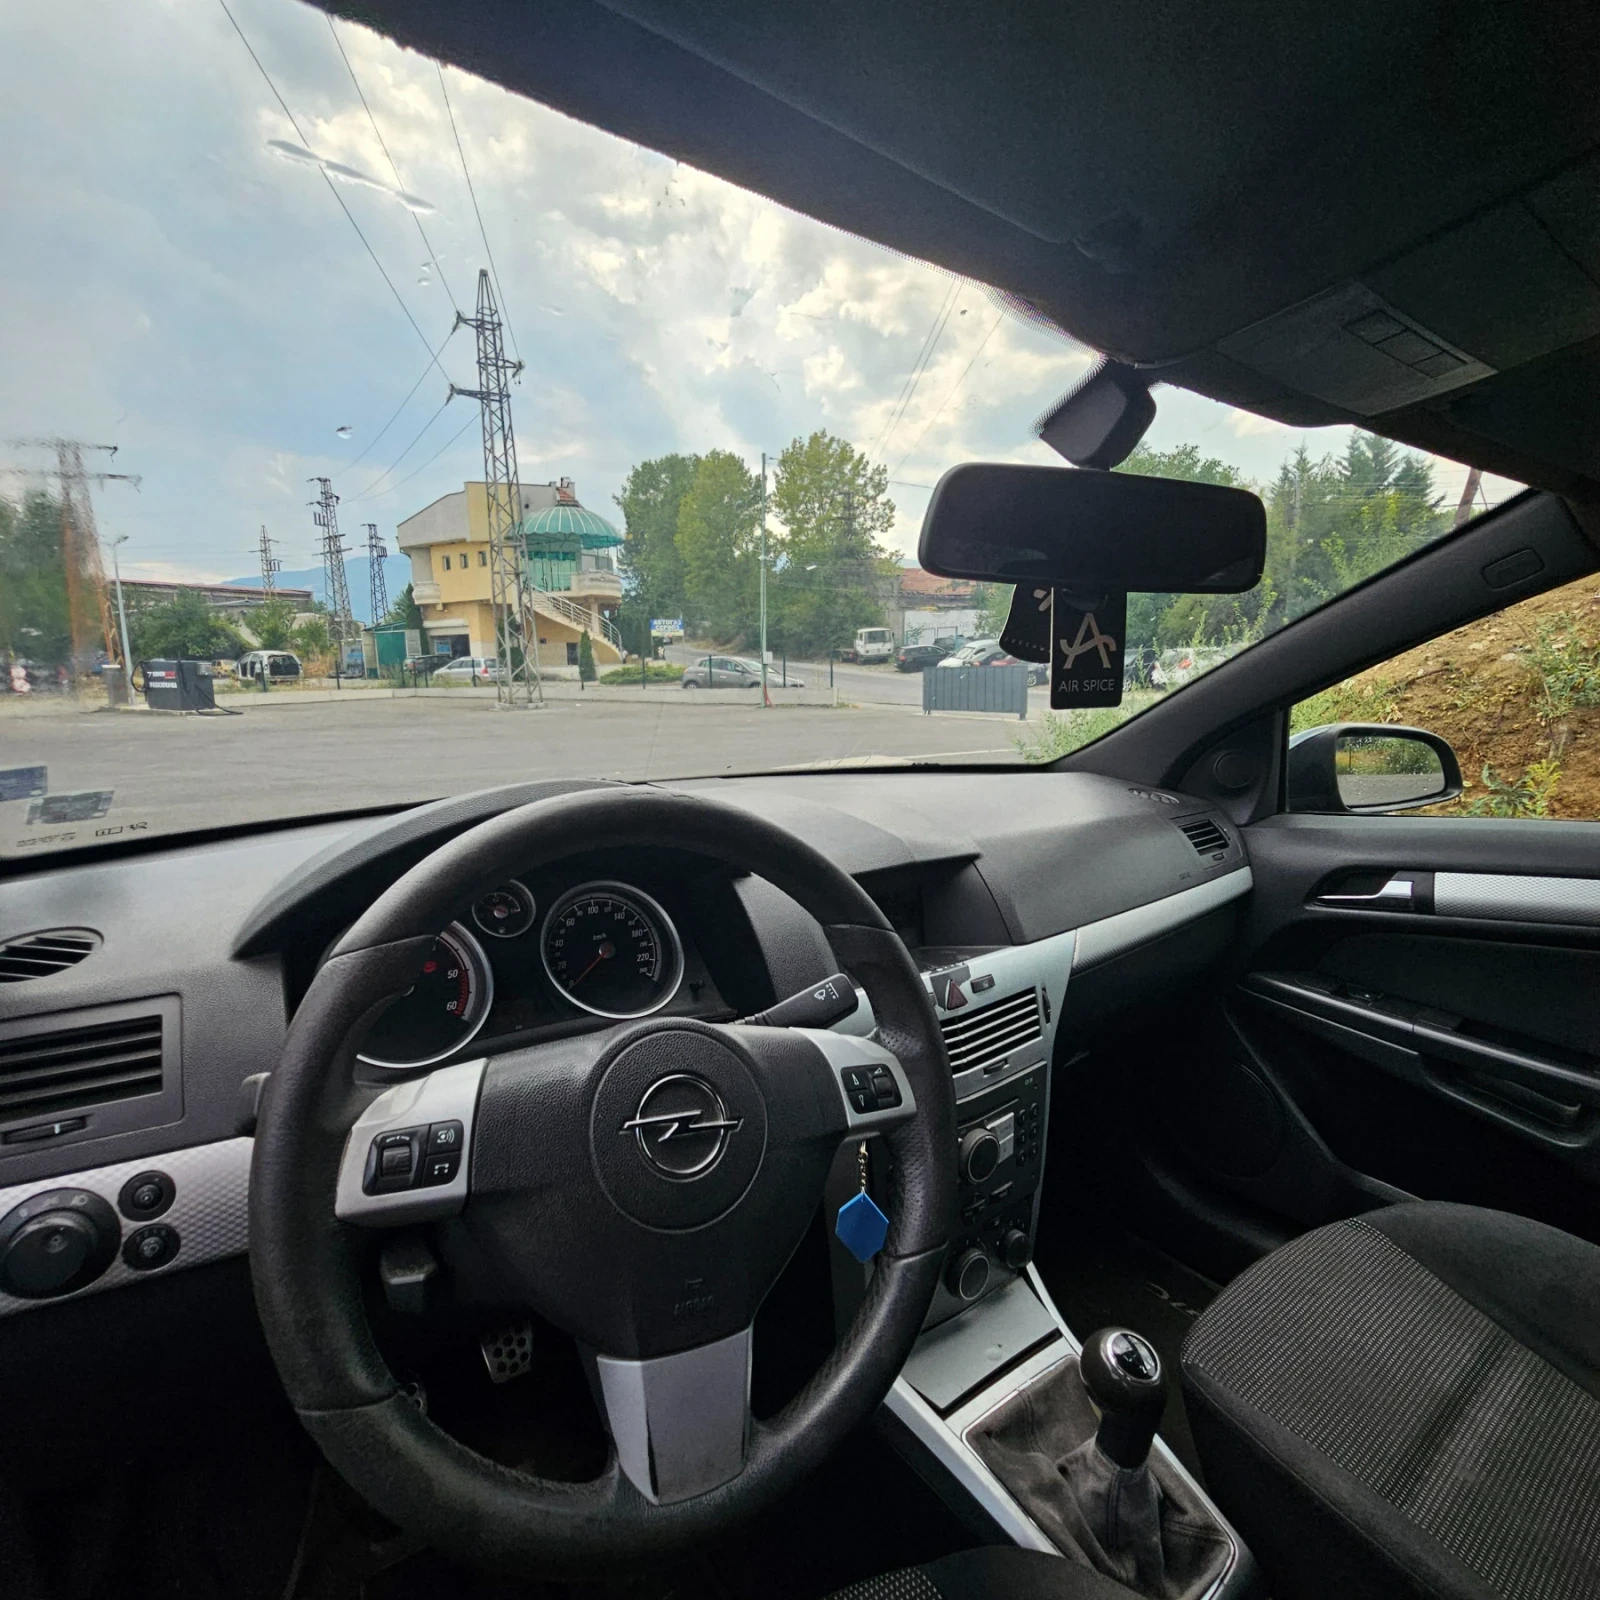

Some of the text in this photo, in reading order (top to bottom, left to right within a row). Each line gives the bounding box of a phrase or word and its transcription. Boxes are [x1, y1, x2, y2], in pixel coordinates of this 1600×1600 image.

[1058, 679, 1115, 692] AIR SPICE
[587, 906, 599, 914] 100
[614, 912, 625, 920] 140
[566, 918, 575, 926] 60
[592, 932, 607, 940] km/h
[631, 929, 643, 938] 180
[555, 939, 564, 947] 40
[636, 953, 650, 962] 220
[557, 961, 567, 970] 20
[447, 969, 459, 979] 50
[446, 1001, 458, 1011] 60
